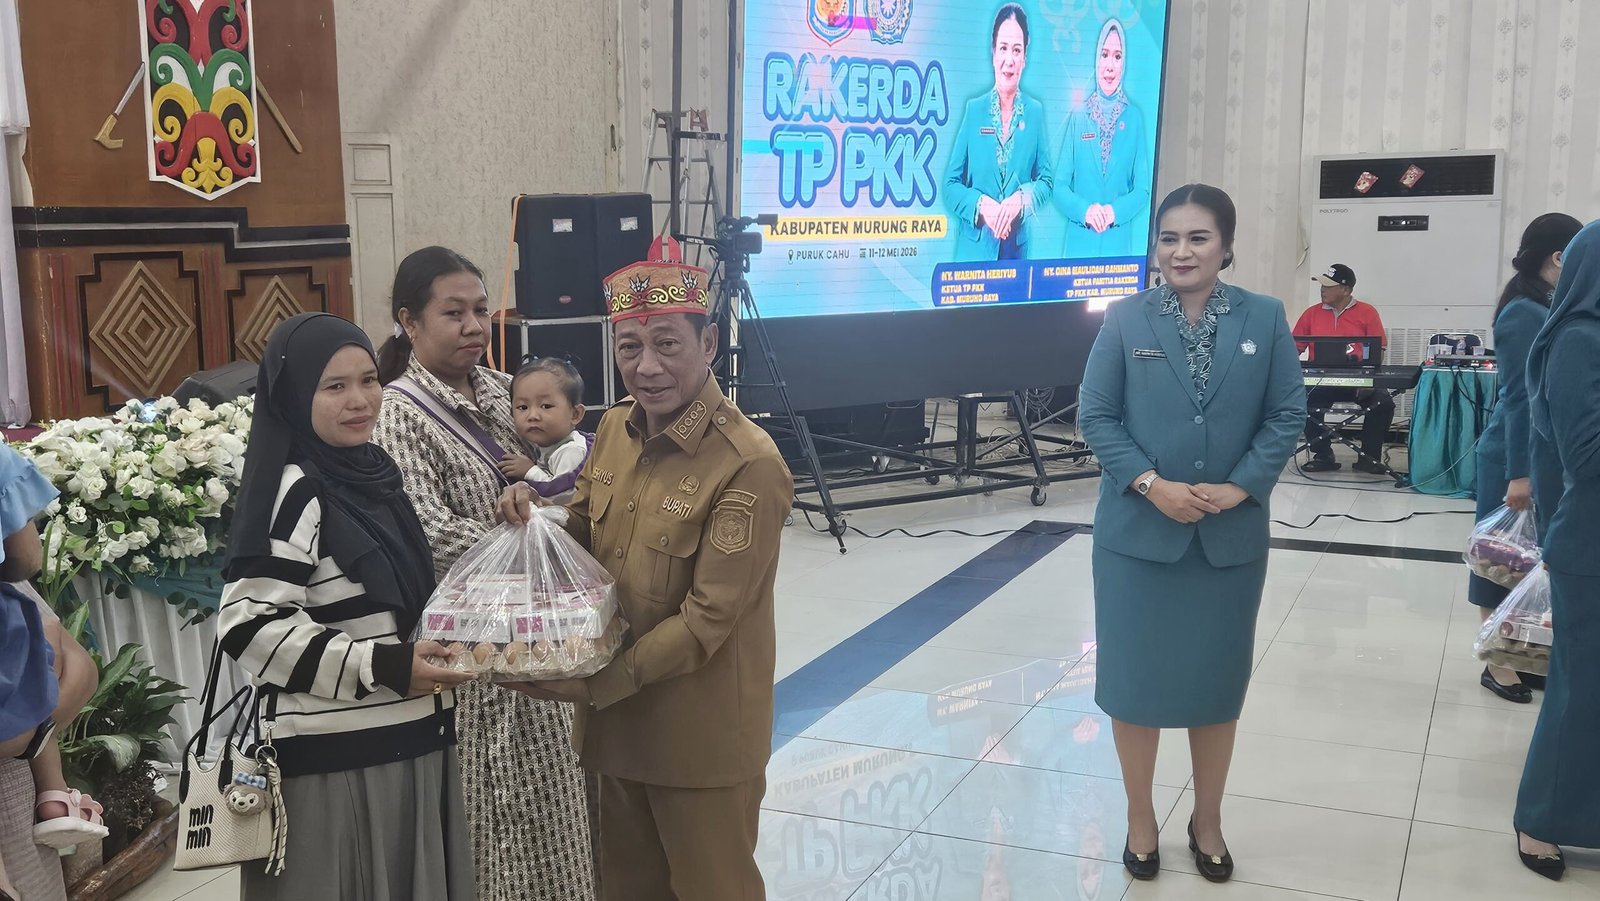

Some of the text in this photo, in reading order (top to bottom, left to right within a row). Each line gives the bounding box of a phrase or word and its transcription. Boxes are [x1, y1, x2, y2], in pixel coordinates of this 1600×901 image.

[764, 53, 949, 126] RAKERDA
[770, 124, 938, 208] TP PKK
[770, 219, 942, 236] KABUPATEN MURUNG RAYA
[796, 249, 850, 261] PURUK CAHU
[868, 247, 918, 258] 11-12 MEI 2026
[963, 284, 971, 292] TP
[662, 496, 693, 518] BUPATI
